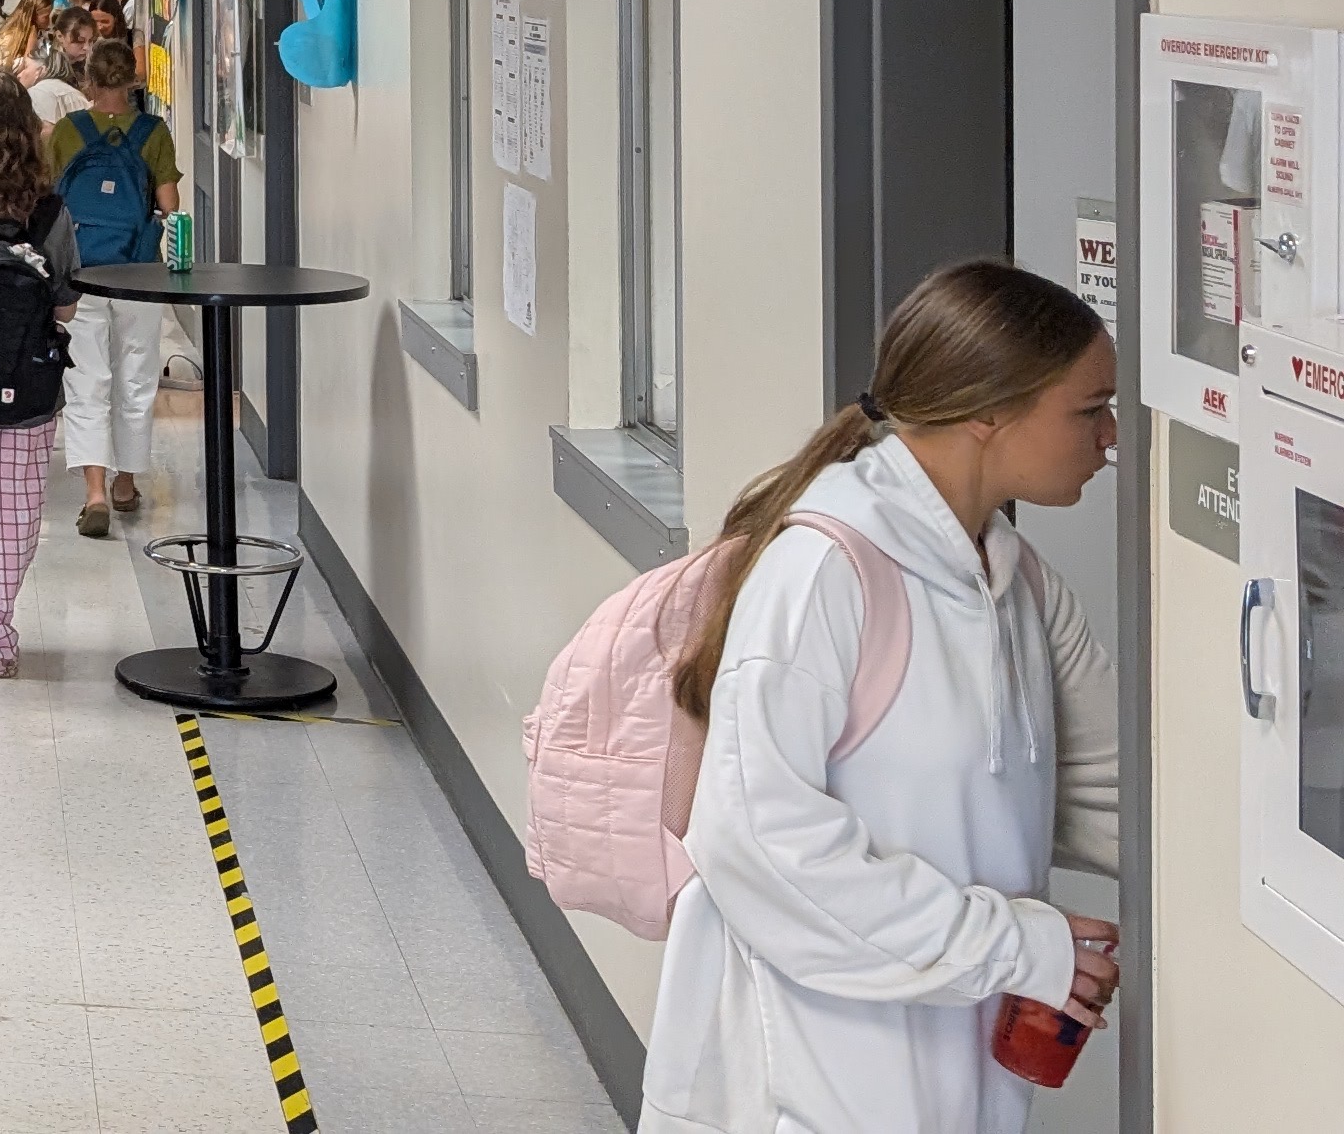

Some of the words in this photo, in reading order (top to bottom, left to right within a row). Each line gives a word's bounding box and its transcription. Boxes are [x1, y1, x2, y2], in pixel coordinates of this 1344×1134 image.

[1161, 38, 1202, 56] OVERDOSE
[1204, 43, 1253, 63] EMERGENCY
[1256, 50, 1270, 65] KIT
[1080, 272, 1092, 284] IF
[1094, 273, 1117, 289] YOU
[1203, 386, 1227, 413] AEK
[1197, 483, 1241, 524] ATTEND
